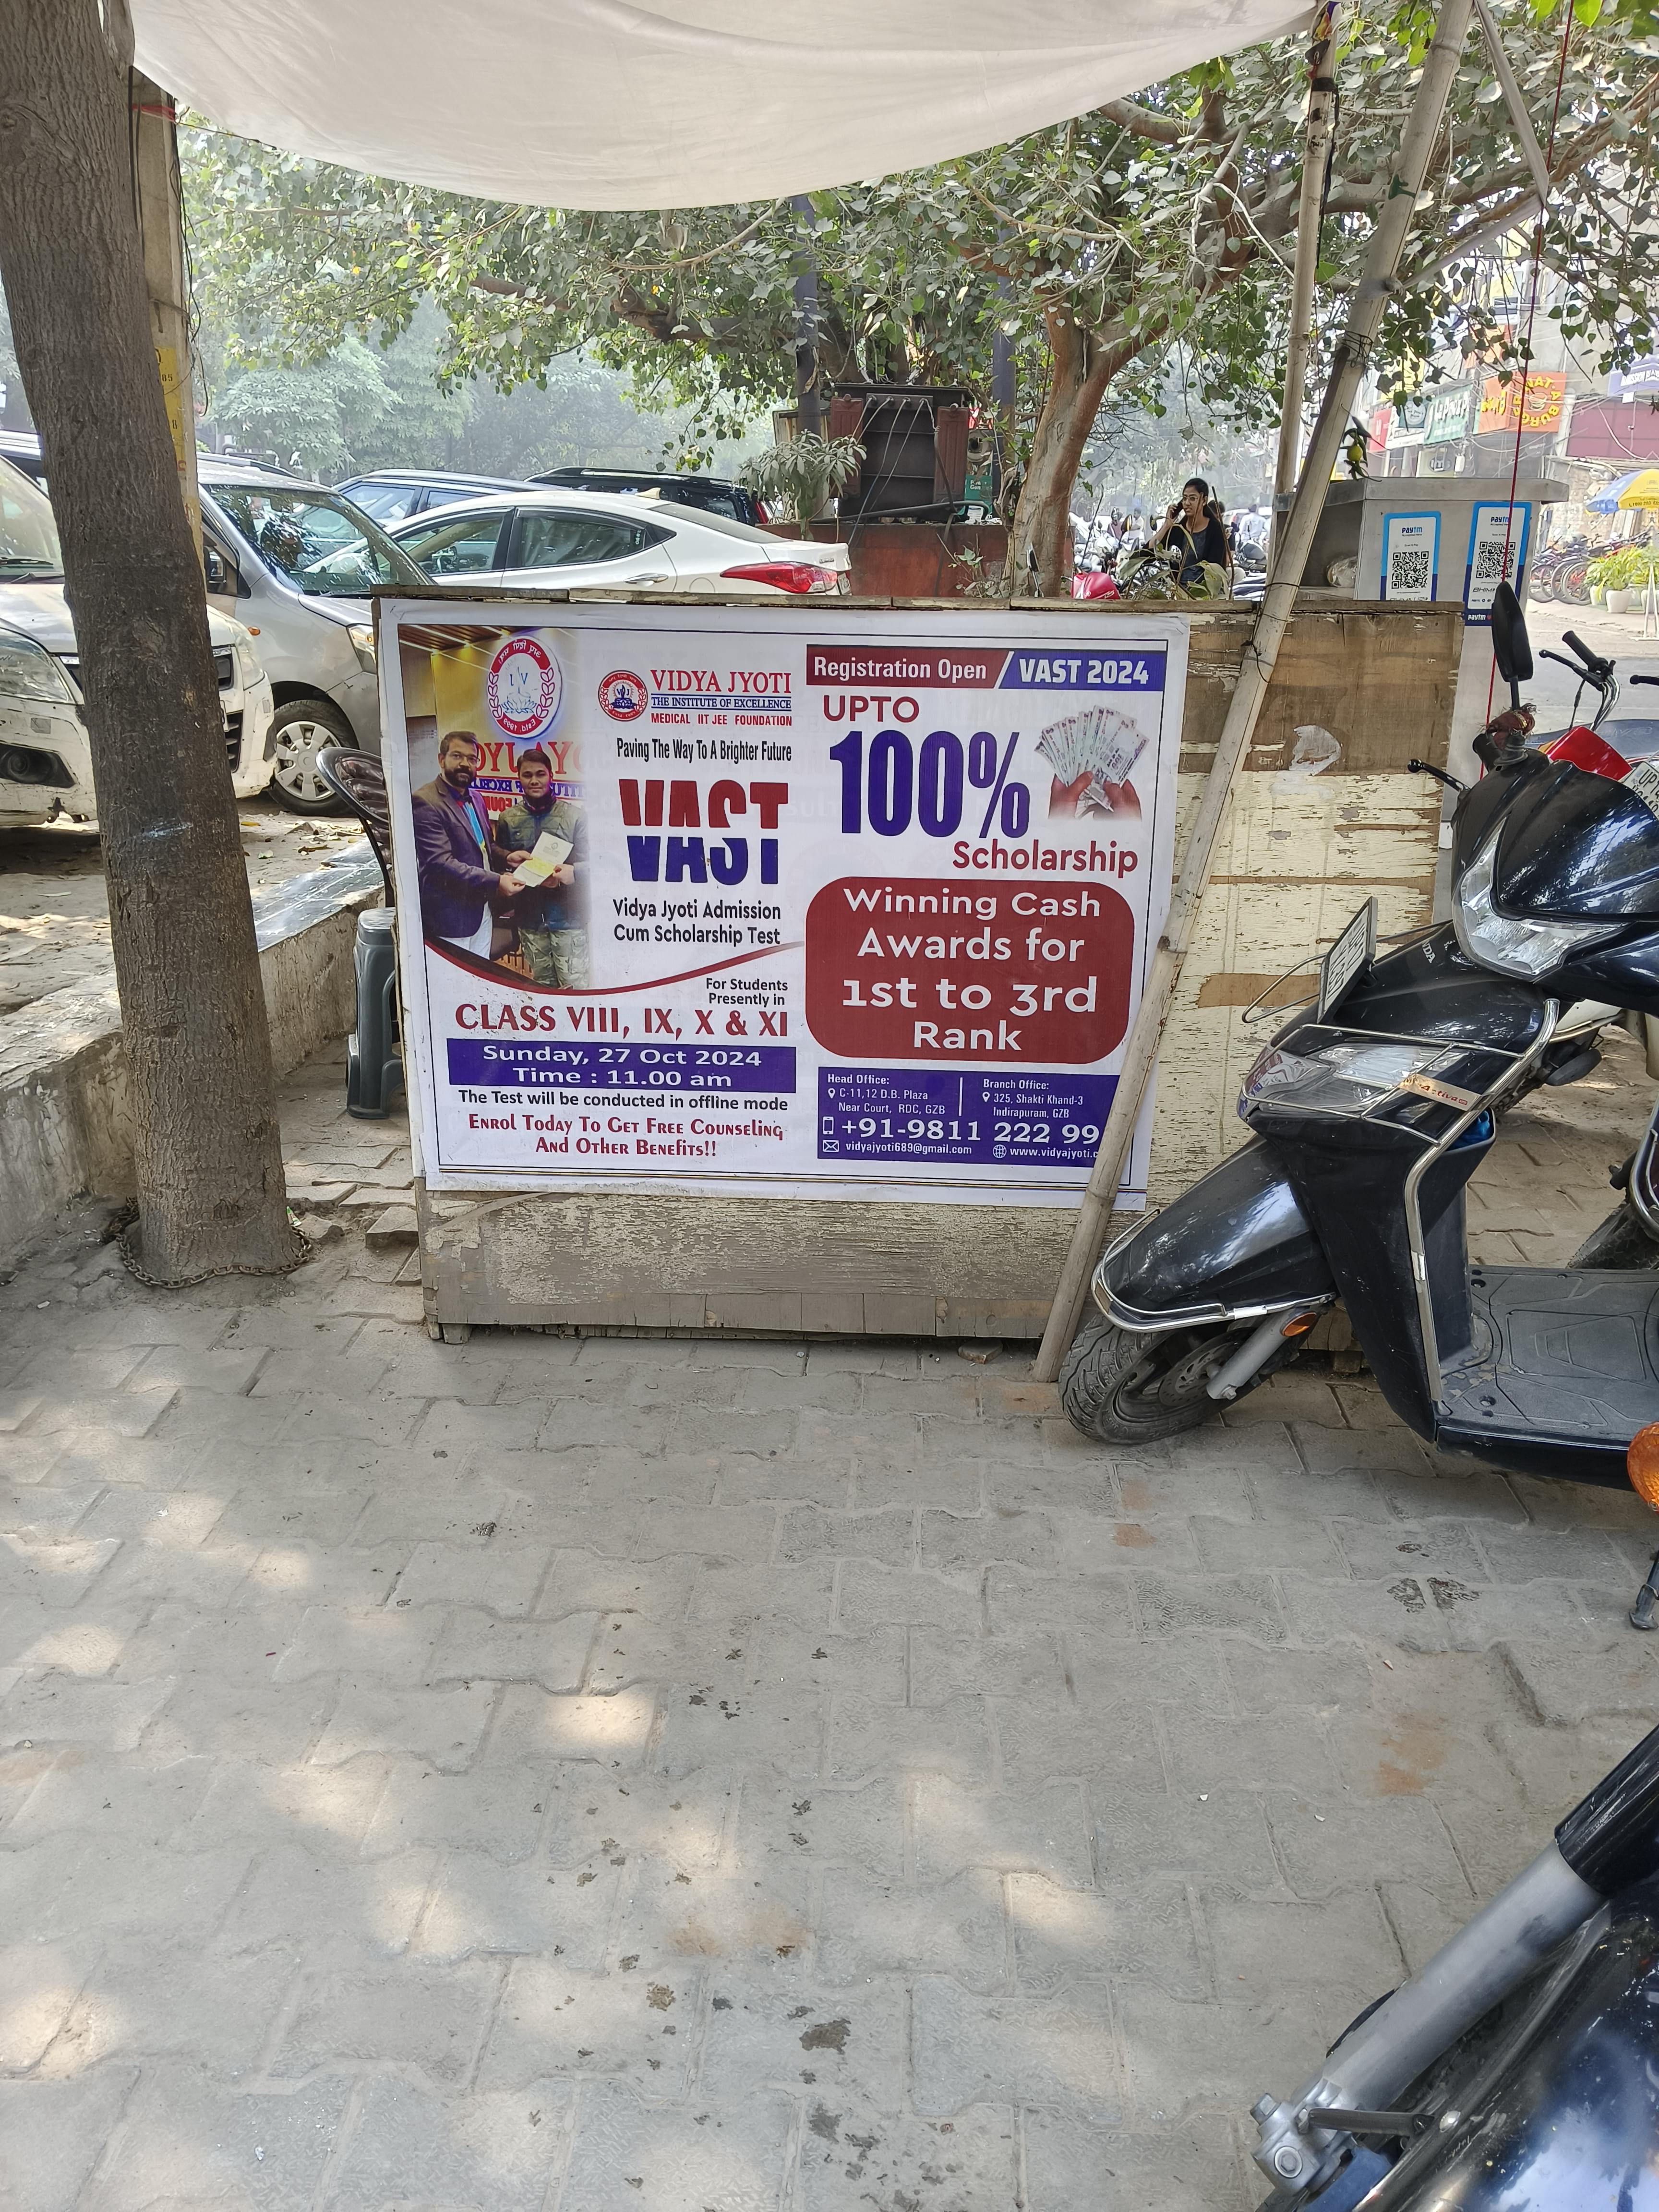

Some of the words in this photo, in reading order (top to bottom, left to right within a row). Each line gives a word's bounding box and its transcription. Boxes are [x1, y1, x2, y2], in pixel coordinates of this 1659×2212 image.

[650, 669, 722, 692] VIDYA
[728, 671, 792, 694] JYOTI
[815, 656, 930, 681] Registration
[938, 659, 986, 683] Open
[1019, 659, 1082, 683] VAST
[1087, 660, 1149, 685] 2024
[651, 697, 669, 708] THE
[672, 697, 717, 709] INSTITUTE
[719, 698, 732, 708] OF
[733, 698, 792, 709] EXCELLENCE
[823, 695, 919, 723] UPTO
[651, 713, 691, 724] MEDICAL
[698, 714, 709, 724] IIT
[711, 714, 728, 725] JEE
[735, 715, 792, 726] FOUNDATION
[617, 737, 649, 762] Paving
[651, 738, 670, 759] The
[673, 739, 694, 764] Way
[696, 739, 707, 759] To
[710, 740, 717, 759] A
[720, 740, 758, 765] Brighter
[761, 741, 792, 761] Future
[830, 730, 1030, 839] 100%
[618, 779, 789, 886] VAST
[952, 838, 1138, 879] Scholarship
[613, 897, 656, 920] Vidya
[661, 899, 697, 921] Jyoti
[703, 900, 781, 920] Admission
[843, 886, 997, 920] Winning
[1011, 891, 1100, 917] Cash
[614, 925, 649, 942] Cum
[654, 923, 743, 948] Scholarship
[747, 926, 780, 945] Test
[857, 926, 1011, 960] Awards
[1026, 927, 1085, 962] for
[1422, 940, 1436, 964] NDA
[706, 977, 727, 990] For
[730, 978, 788, 991] Students
[843, 977, 917, 1008] 1st
[936, 978, 992, 1010] to
[1009, 975, 1097, 1017] 3rd
[709, 992, 769, 1008] Presently
[773, 994, 785, 1006] in
[455, 1003, 556, 1032] CLASS
[566, 1006, 630, 1040] VIII,
[644, 1008, 682, 1041] IX,
[695, 1010, 715, 1035] X
[725, 1010, 748, 1036] &
[758, 1010, 787, 1037] XI
[914, 1020, 1022, 1050] Rank
[483, 1045, 589, 1065] Sunday,
[599, 1048, 630, 1063] 27
[640, 1049, 687, 1064] Oct
[696, 1050, 762, 1066] 2024
[512, 1068, 581, 1083] Time
[607, 1070, 681, 1085] 11.00
[690, 1073, 731, 1087] am
[828, 1073, 853, 1083] Head
[856, 1074, 890, 1084] Office:
[983, 1079, 1016, 1089] Branch
[1019, 1080, 1049, 1090] Office:
[458, 1089, 487, 1104] The
[491, 1091, 523, 1104] Test
[527, 1091, 554, 1105] will
[560, 1091, 579, 1106] be
[583, 1093, 664, 1107] conducted
[670, 1094, 684, 1108] in
[689, 1095, 739, 1109] offline
[744, 1096, 788, 1110] mode
[881, 1089, 901, 1099] D.B.
[904, 1090, 928, 1100] Plaza
[1016, 1094, 1044, 1104] Shakti
[839, 1102, 861, 1112] Near
[864, 1103, 892, 1114] Court,
[899, 1104, 922, 1115] RDC,
[925, 1105, 945, 1114] GZB
[993, 1106, 1049, 1119] Indirapuram,
[1053, 1108, 1069, 1118] GZB
[842, 1118, 981, 1141] +91-9811
[994, 1122, 1050, 1143] 222
[1062, 1124, 1099, 1144] 99
[845, 1141, 972, 1155] vidyajyoti689@gmail.com
[1010, 1146, 1098, 1160] www.vidyajyoti.c
